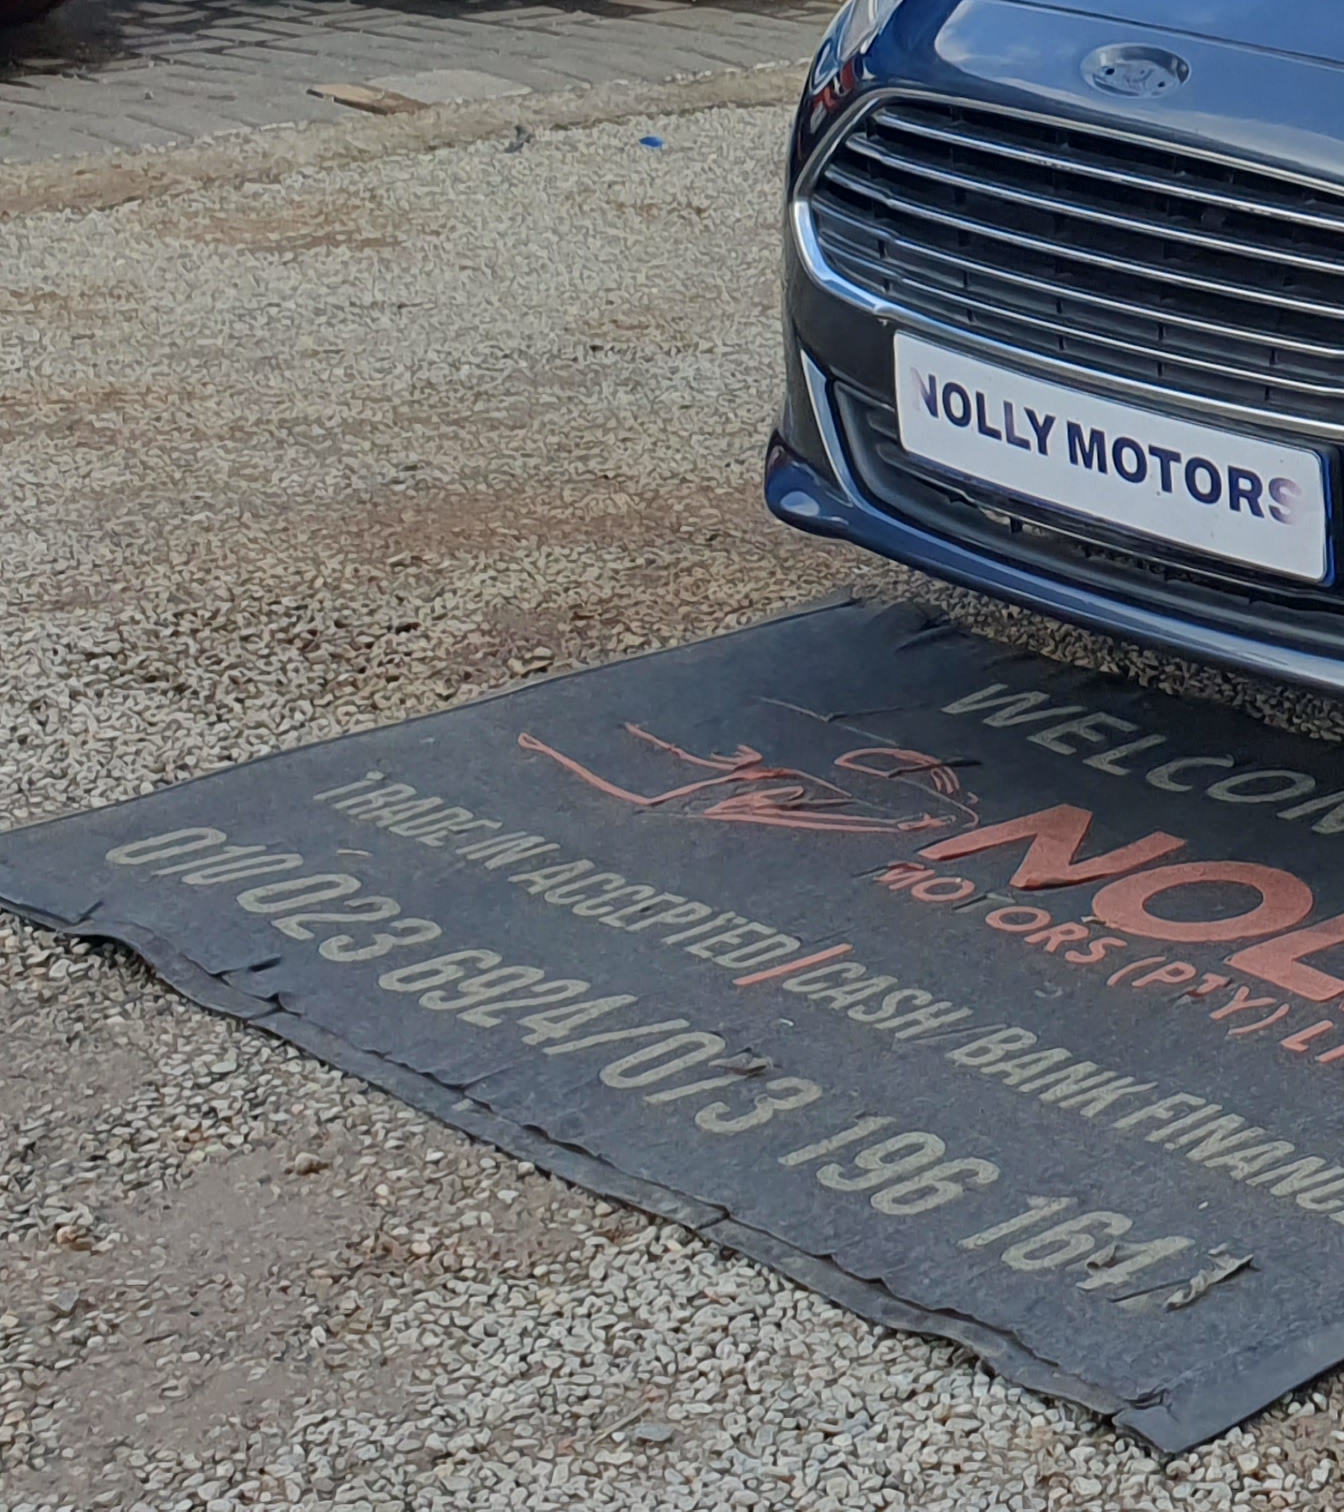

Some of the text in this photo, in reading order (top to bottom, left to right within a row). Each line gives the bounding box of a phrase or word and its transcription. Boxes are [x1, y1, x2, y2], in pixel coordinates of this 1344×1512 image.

[909, 365, 1303, 526] NOLLY MOTORS
[312, 769, 503, 847] TRADE
[455, 830, 561, 871] IN
[104, 826, 304, 886] 010
[235, 873, 443, 963] 023
[776, 1113, 1000, 1216] 196
